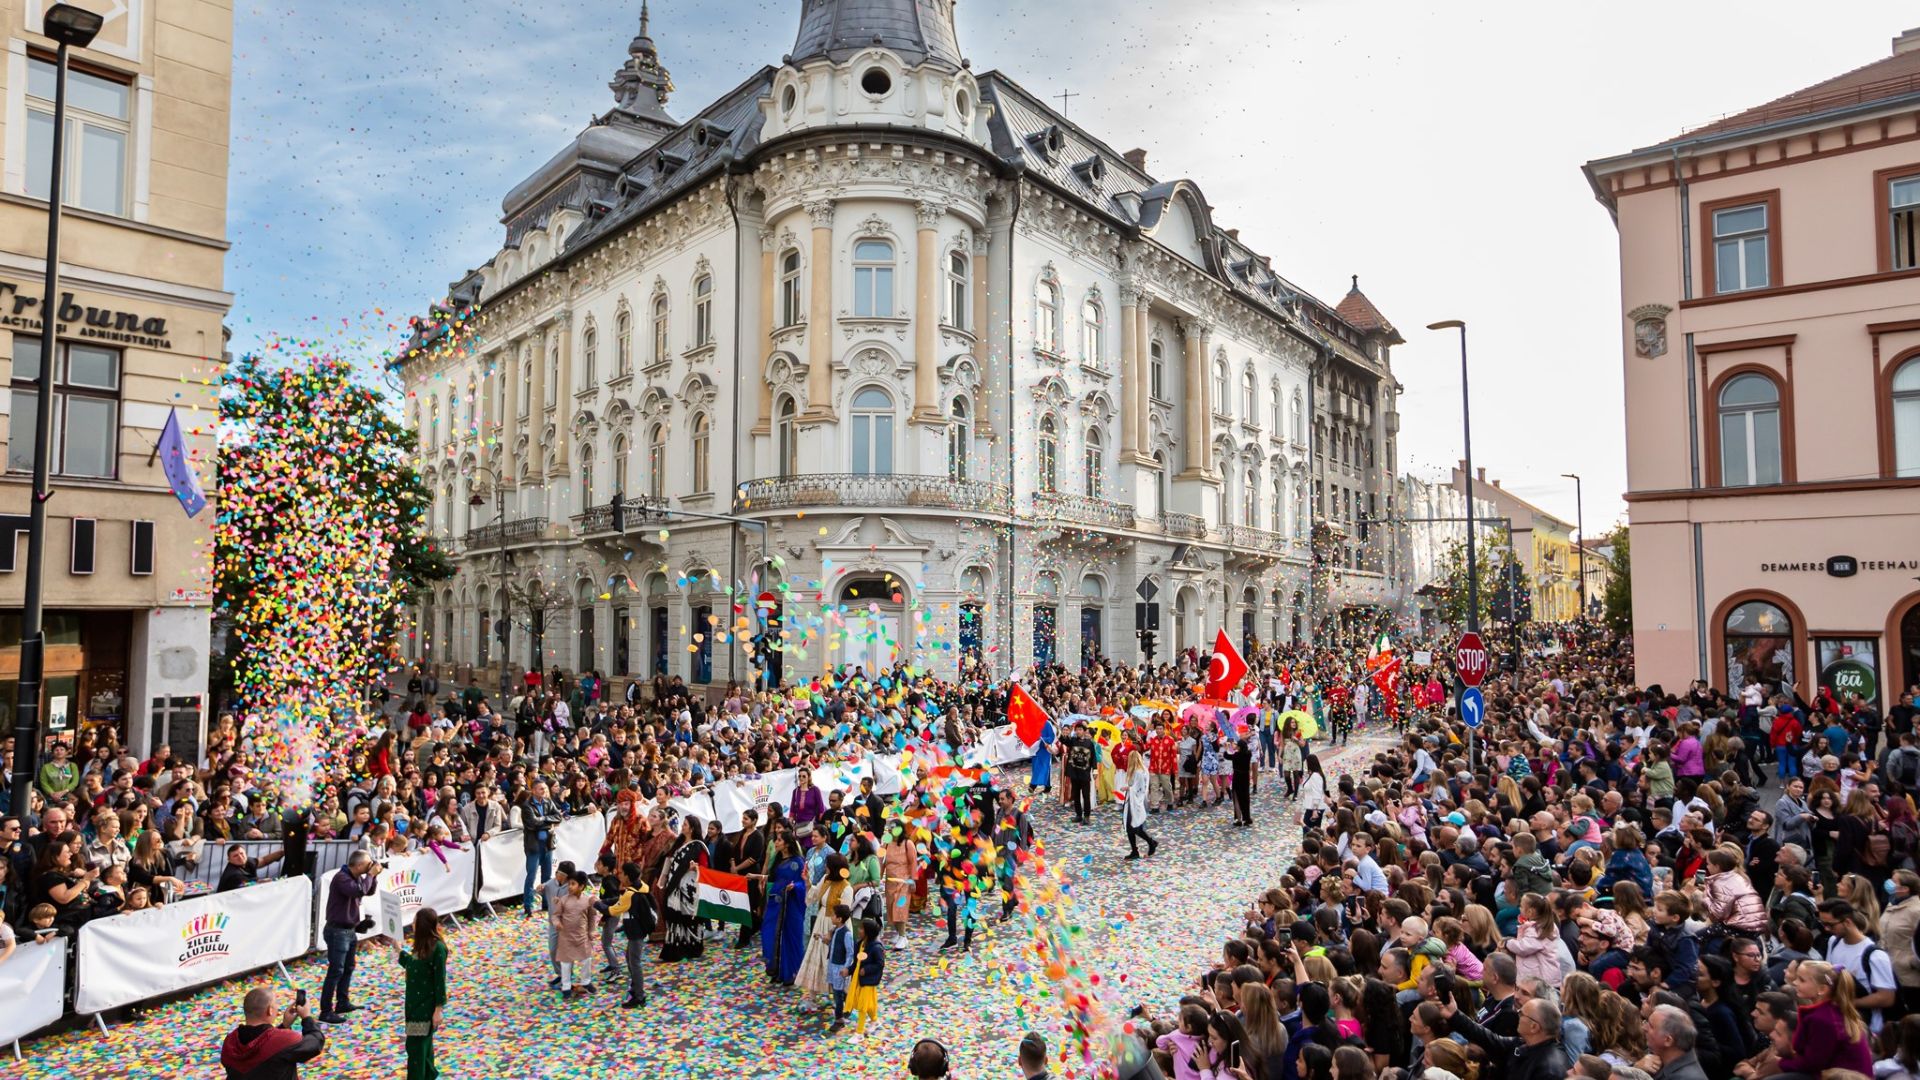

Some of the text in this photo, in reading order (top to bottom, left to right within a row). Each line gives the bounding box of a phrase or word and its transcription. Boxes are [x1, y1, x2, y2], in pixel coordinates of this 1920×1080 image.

[80, 327, 172, 349] ADMINISTRAȚIA
[1761, 562, 1825, 572] DEMMERS
[1458, 648, 1485, 671] STOP
[1834, 671, 1863, 687] tea
[400, 896, 423, 904] JULUI
[187, 934, 221, 949] ZILELE
[178, 943, 229, 962] CLUJULUI
